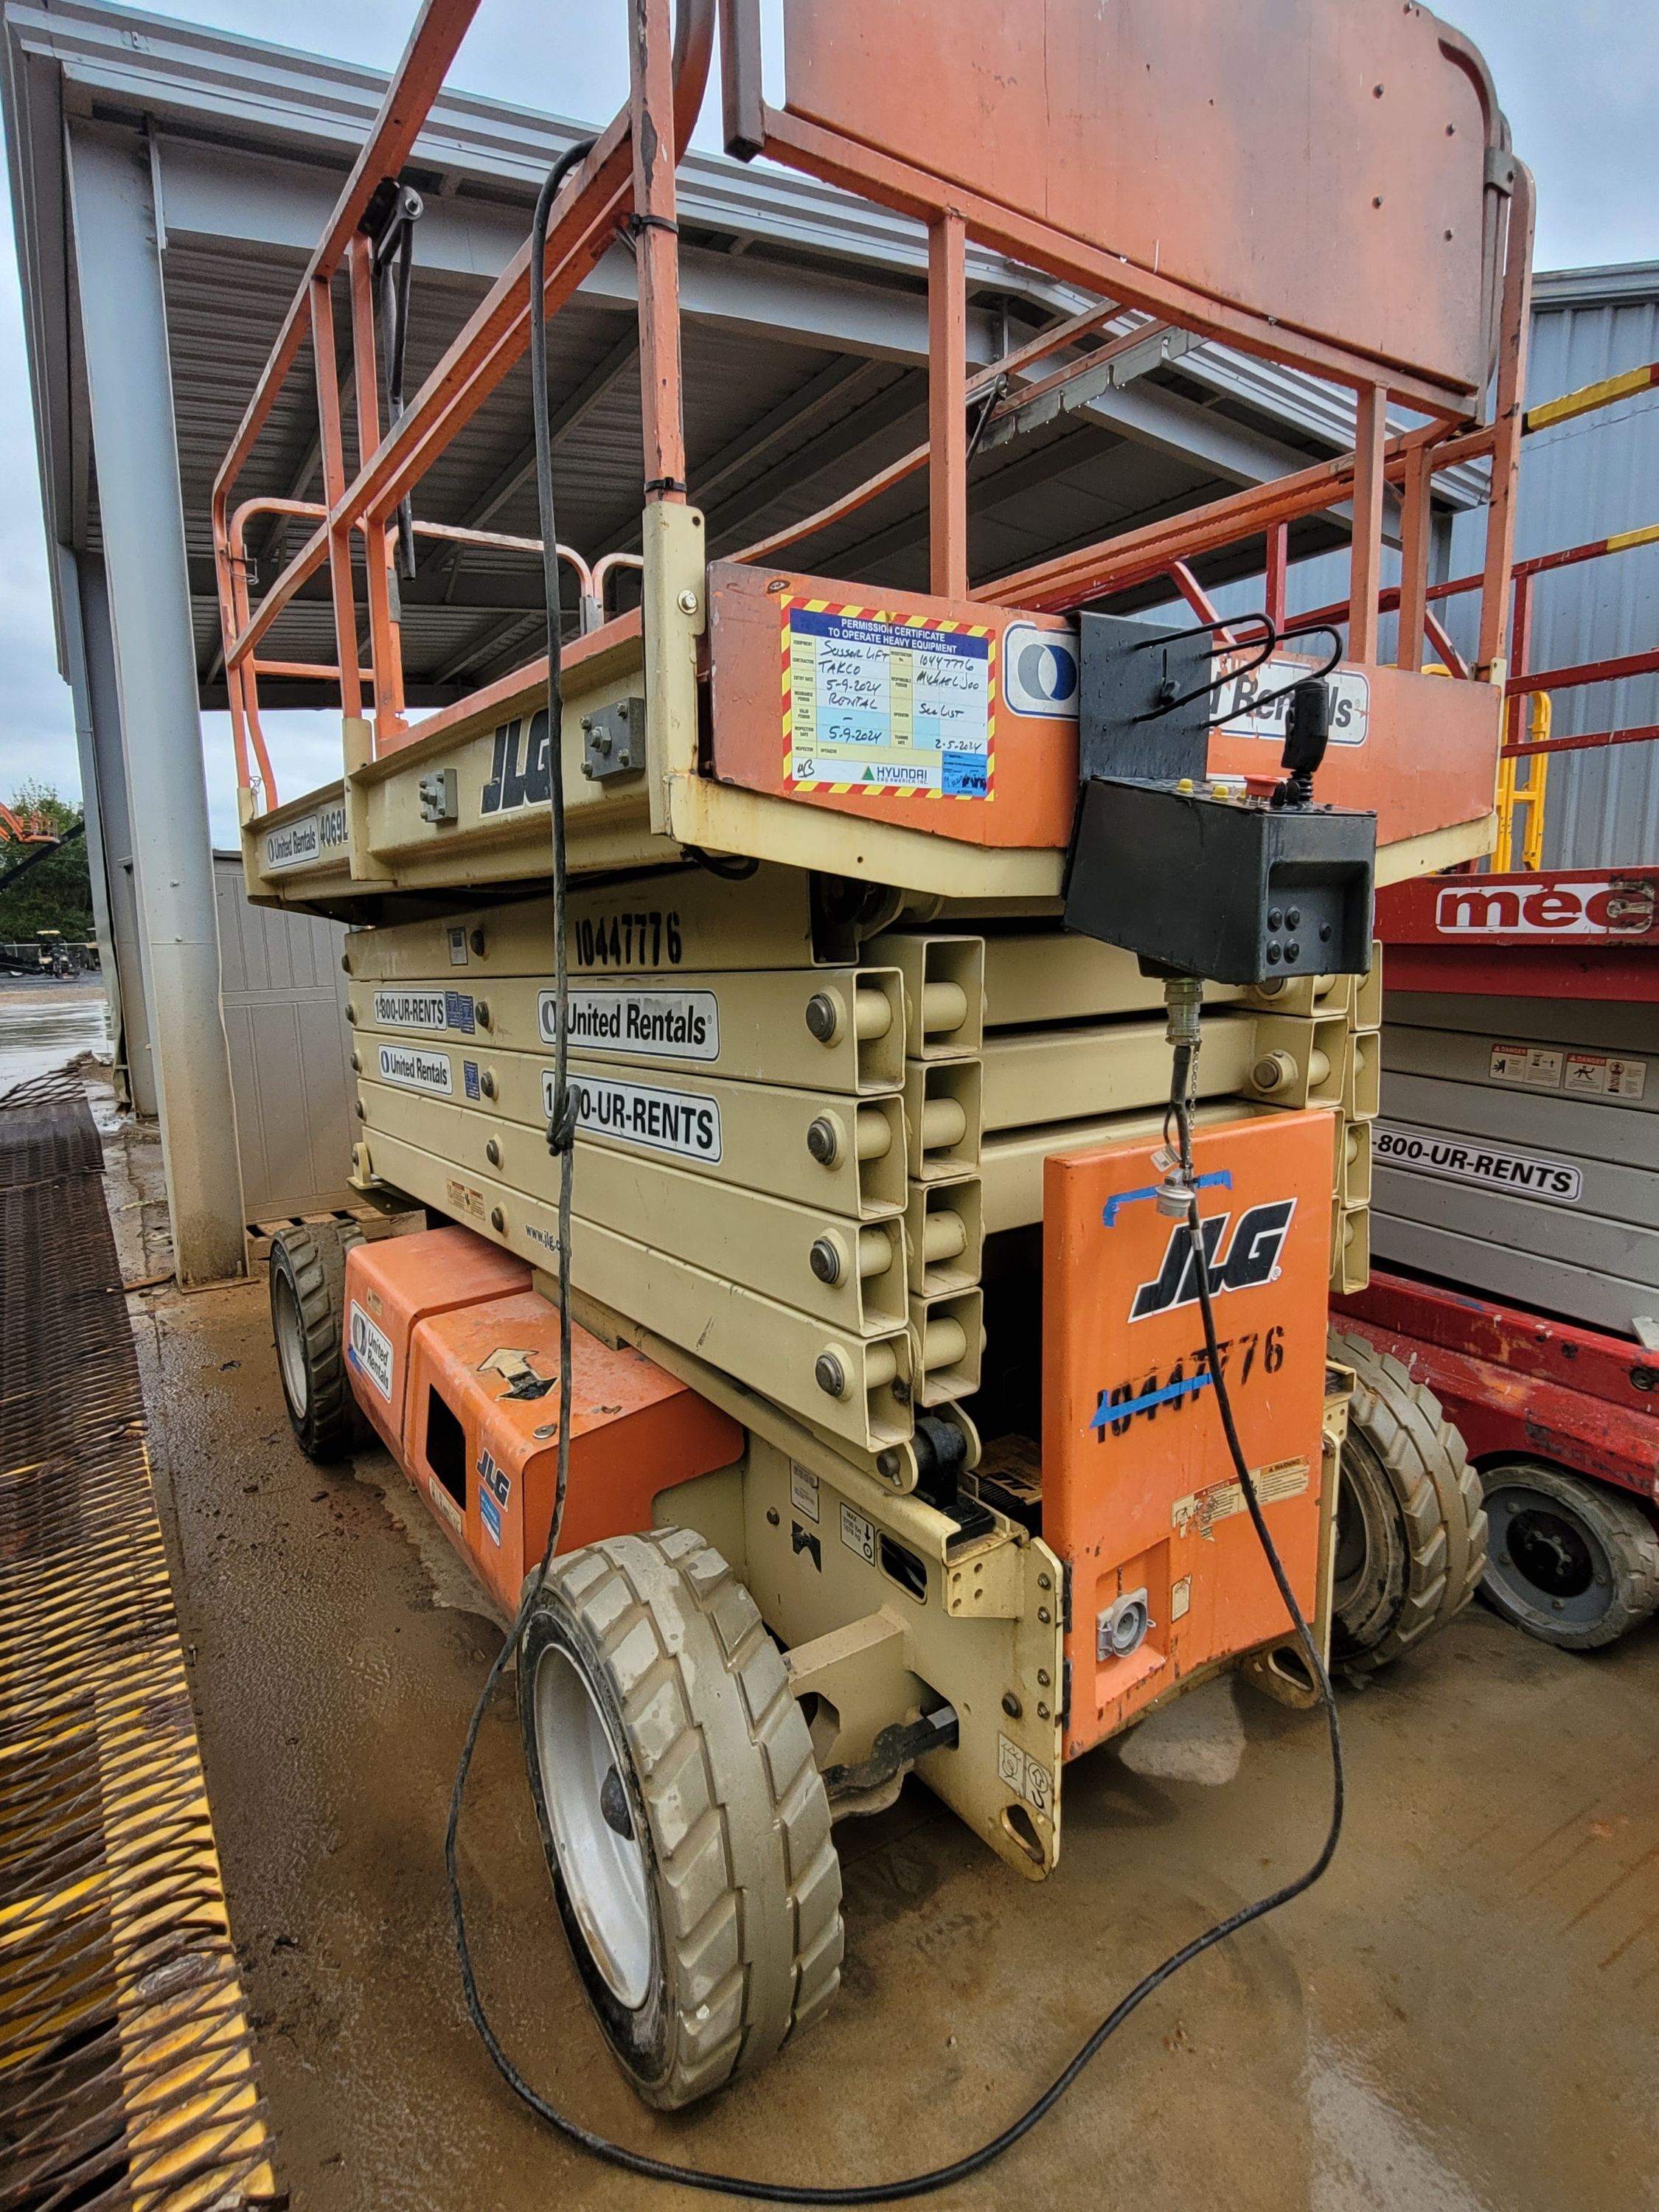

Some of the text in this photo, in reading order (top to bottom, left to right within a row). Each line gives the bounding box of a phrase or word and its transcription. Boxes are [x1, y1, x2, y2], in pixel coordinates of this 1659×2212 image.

[828, 627, 957, 654] TO OPERATE HEAVY EQUIPMENT
[841, 618, 945, 642] PERMISSION CERTIFICATE
[919, 654, 974, 672] 10447776
[877, 766, 928, 780] HYUNDAI
[274, 824, 316, 860] United Rentals
[575, 911, 682, 967] 10447776
[375, 997, 444, 1025] 1-800-UR-RENTS
[566, 1002, 706, 1046] United Rentals
[389, 1052, 415, 1079] United
[416, 1057, 448, 1087] Rentals
[546, 1082, 714, 1150] 10-UR-RENTS
[1130, 1199, 1296, 1321] JLG
[368, 1329, 389, 1367] United
[366, 1348, 389, 1391] Rentals
[476, 1447, 511, 1508] JLG
